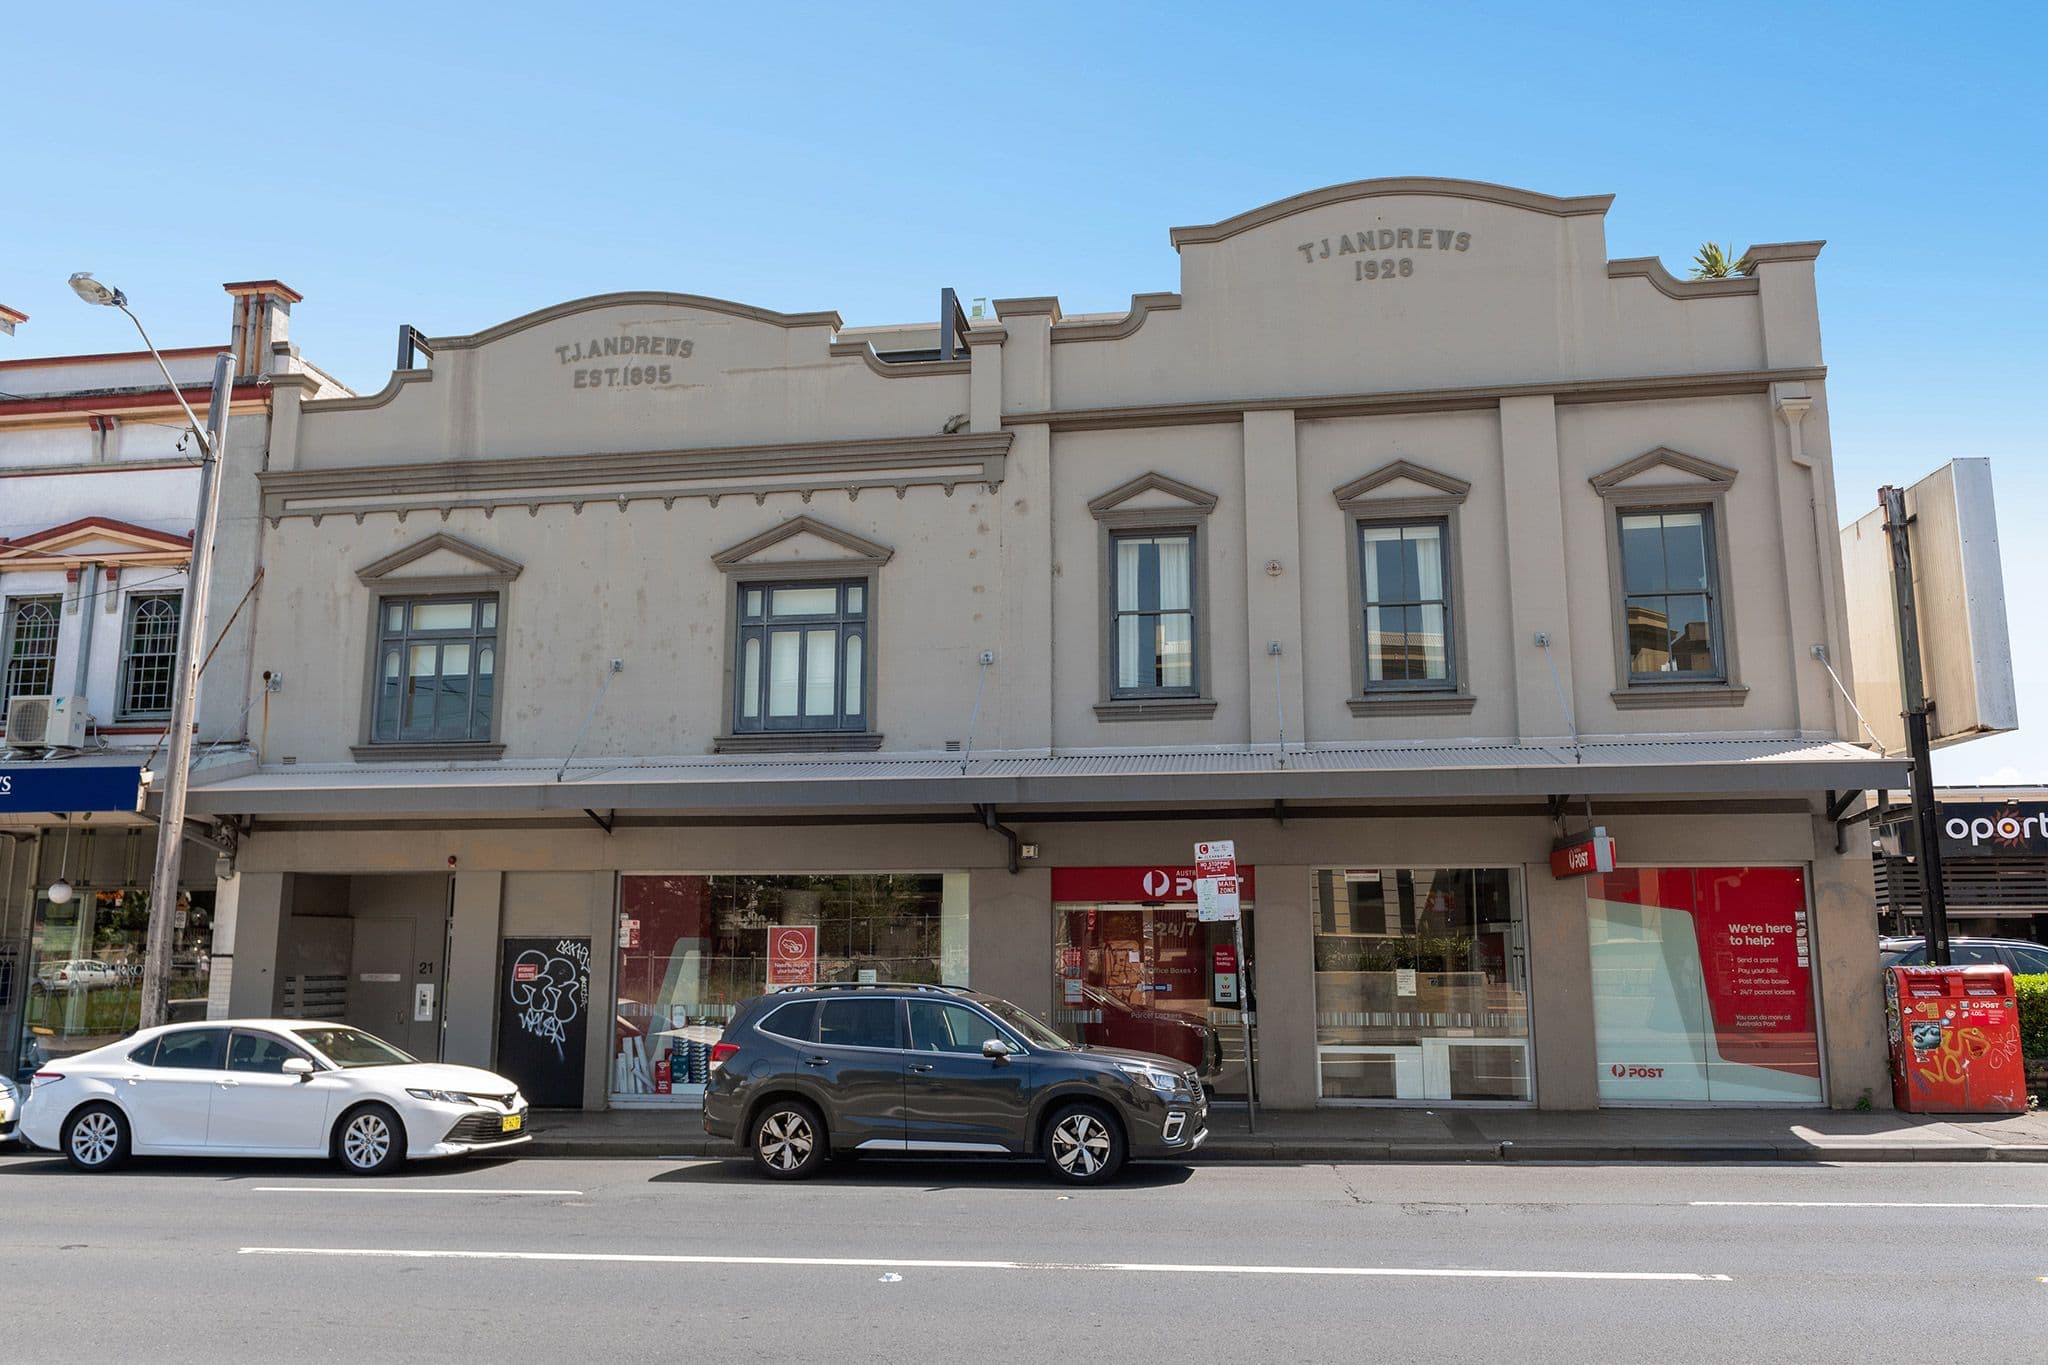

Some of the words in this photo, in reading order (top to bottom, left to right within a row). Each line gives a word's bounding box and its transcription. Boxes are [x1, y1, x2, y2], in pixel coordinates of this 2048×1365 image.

[1338, 228, 1472, 256] ANDREWS
[1355, 257, 1414, 281] 1928
[1574, 851, 1589, 868] POST
[1155, 921, 1197, 938] 24/7
[1728, 923, 1764, 934] We're
[1765, 923, 1793, 934] here
[1729, 936, 1743, 946] to
[1745, 936, 1775, 948] help:
[418, 962, 434, 975] 21
[1130, 1011, 1154, 1019] Parcel
[1628, 1068, 1665, 1078] POST
